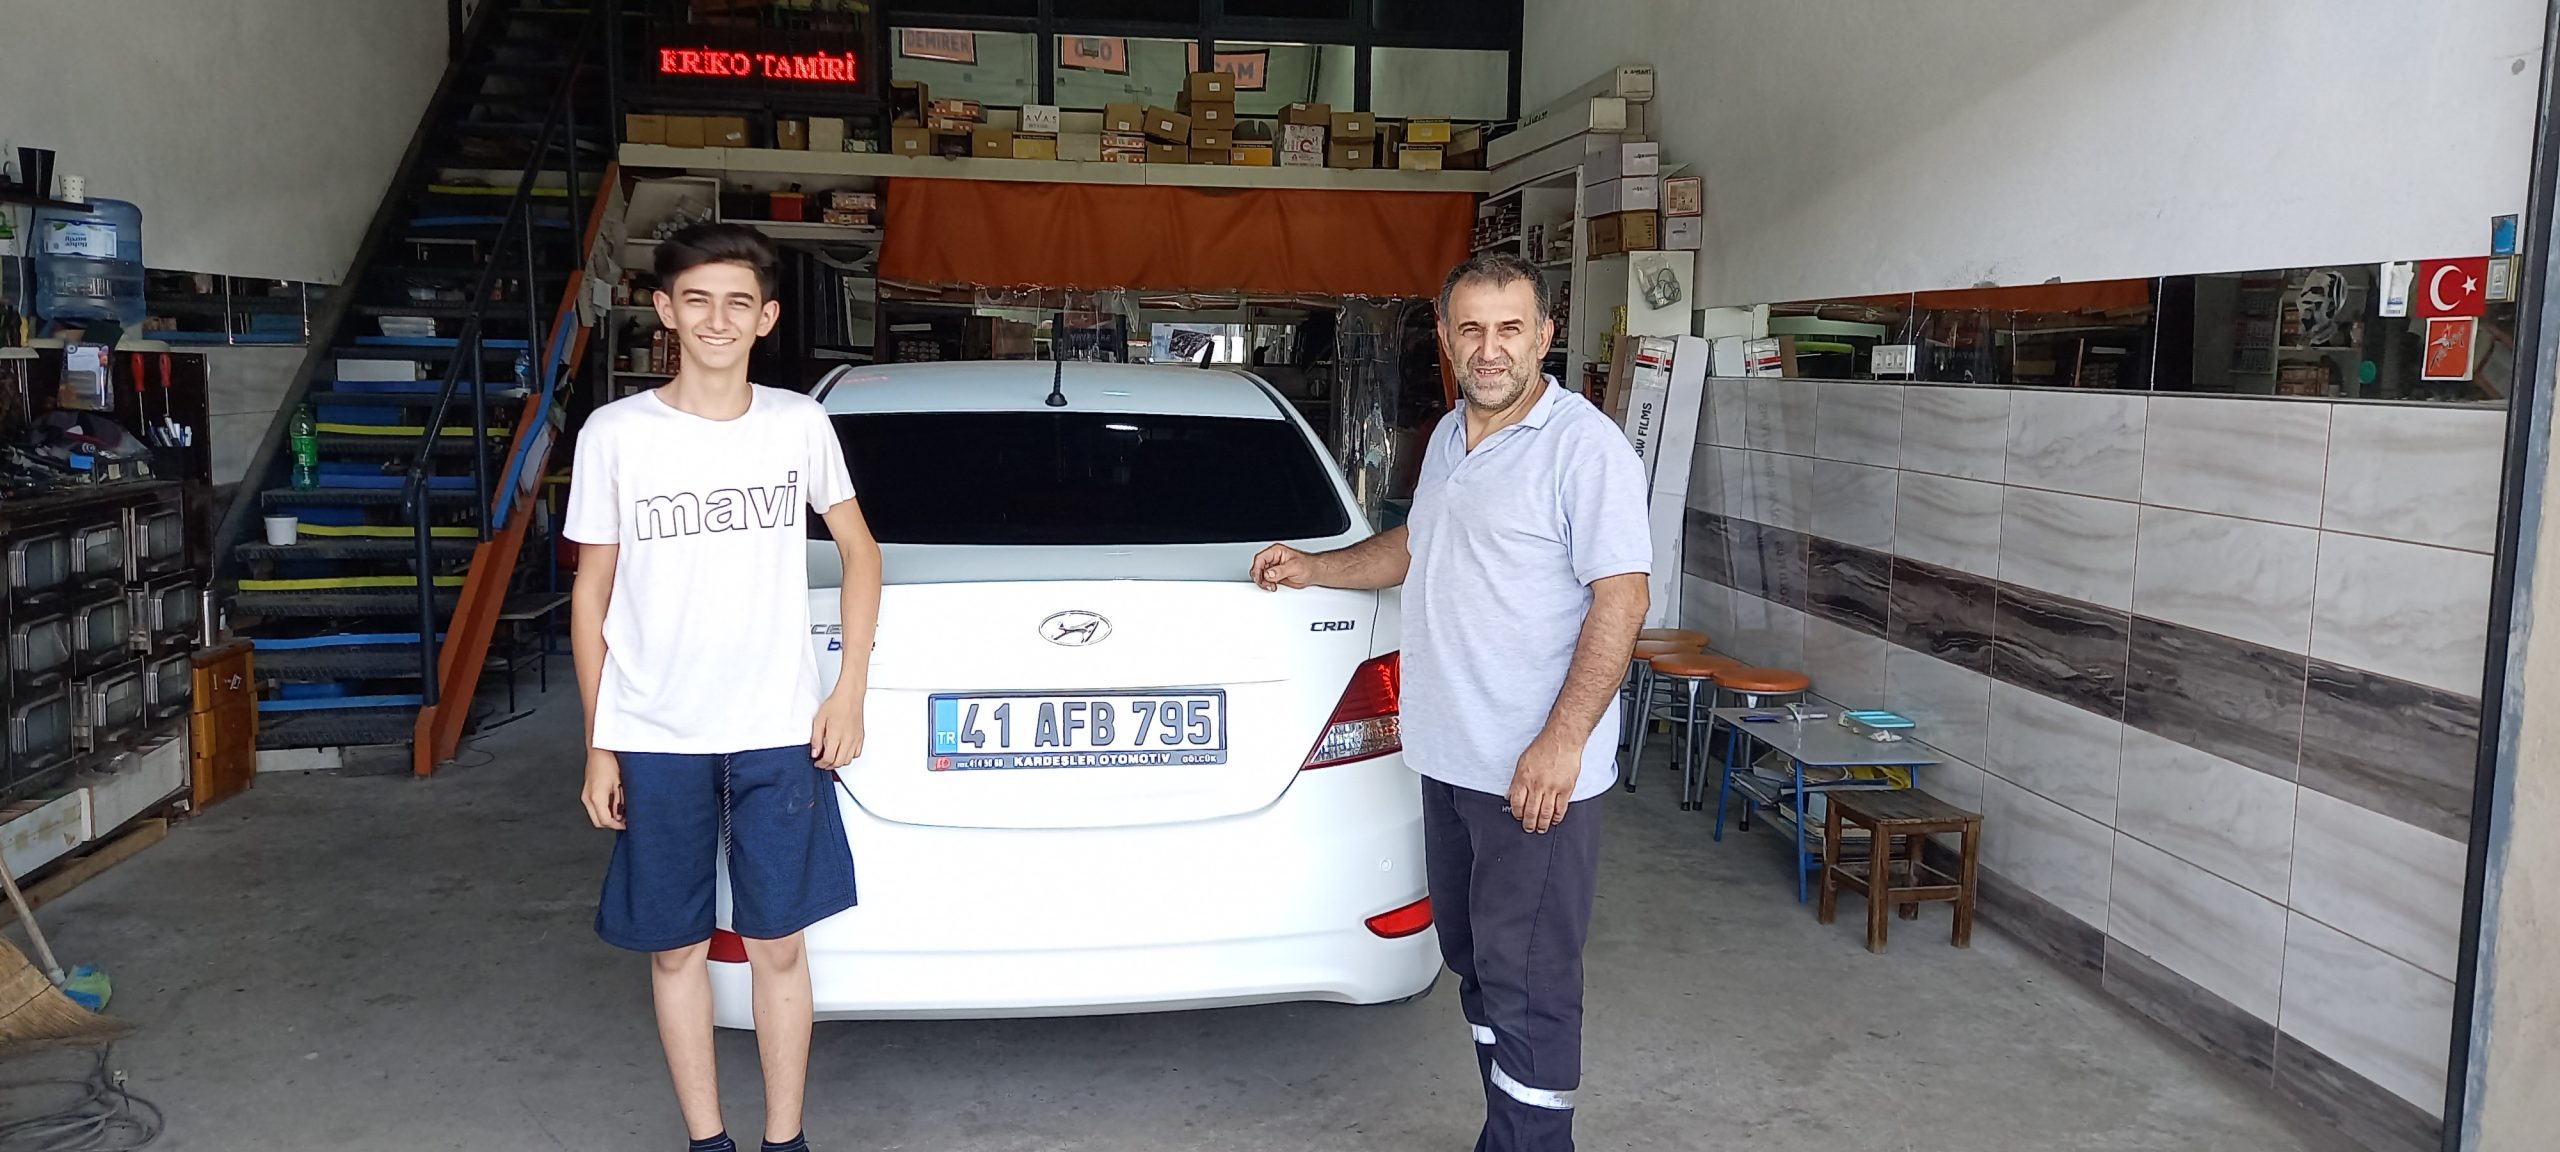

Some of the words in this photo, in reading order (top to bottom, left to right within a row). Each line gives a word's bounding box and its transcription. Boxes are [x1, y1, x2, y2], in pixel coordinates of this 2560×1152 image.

[1638, 402, 1652, 436] FILMS
[635, 471, 798, 541] mavi
[1310, 619, 1356, 632] CRDI
[937, 731, 956, 745] TR
[961, 702, 1010, 748] 41
[1035, 701, 1115, 747] AFB
[1132, 700, 1211, 746] 795
